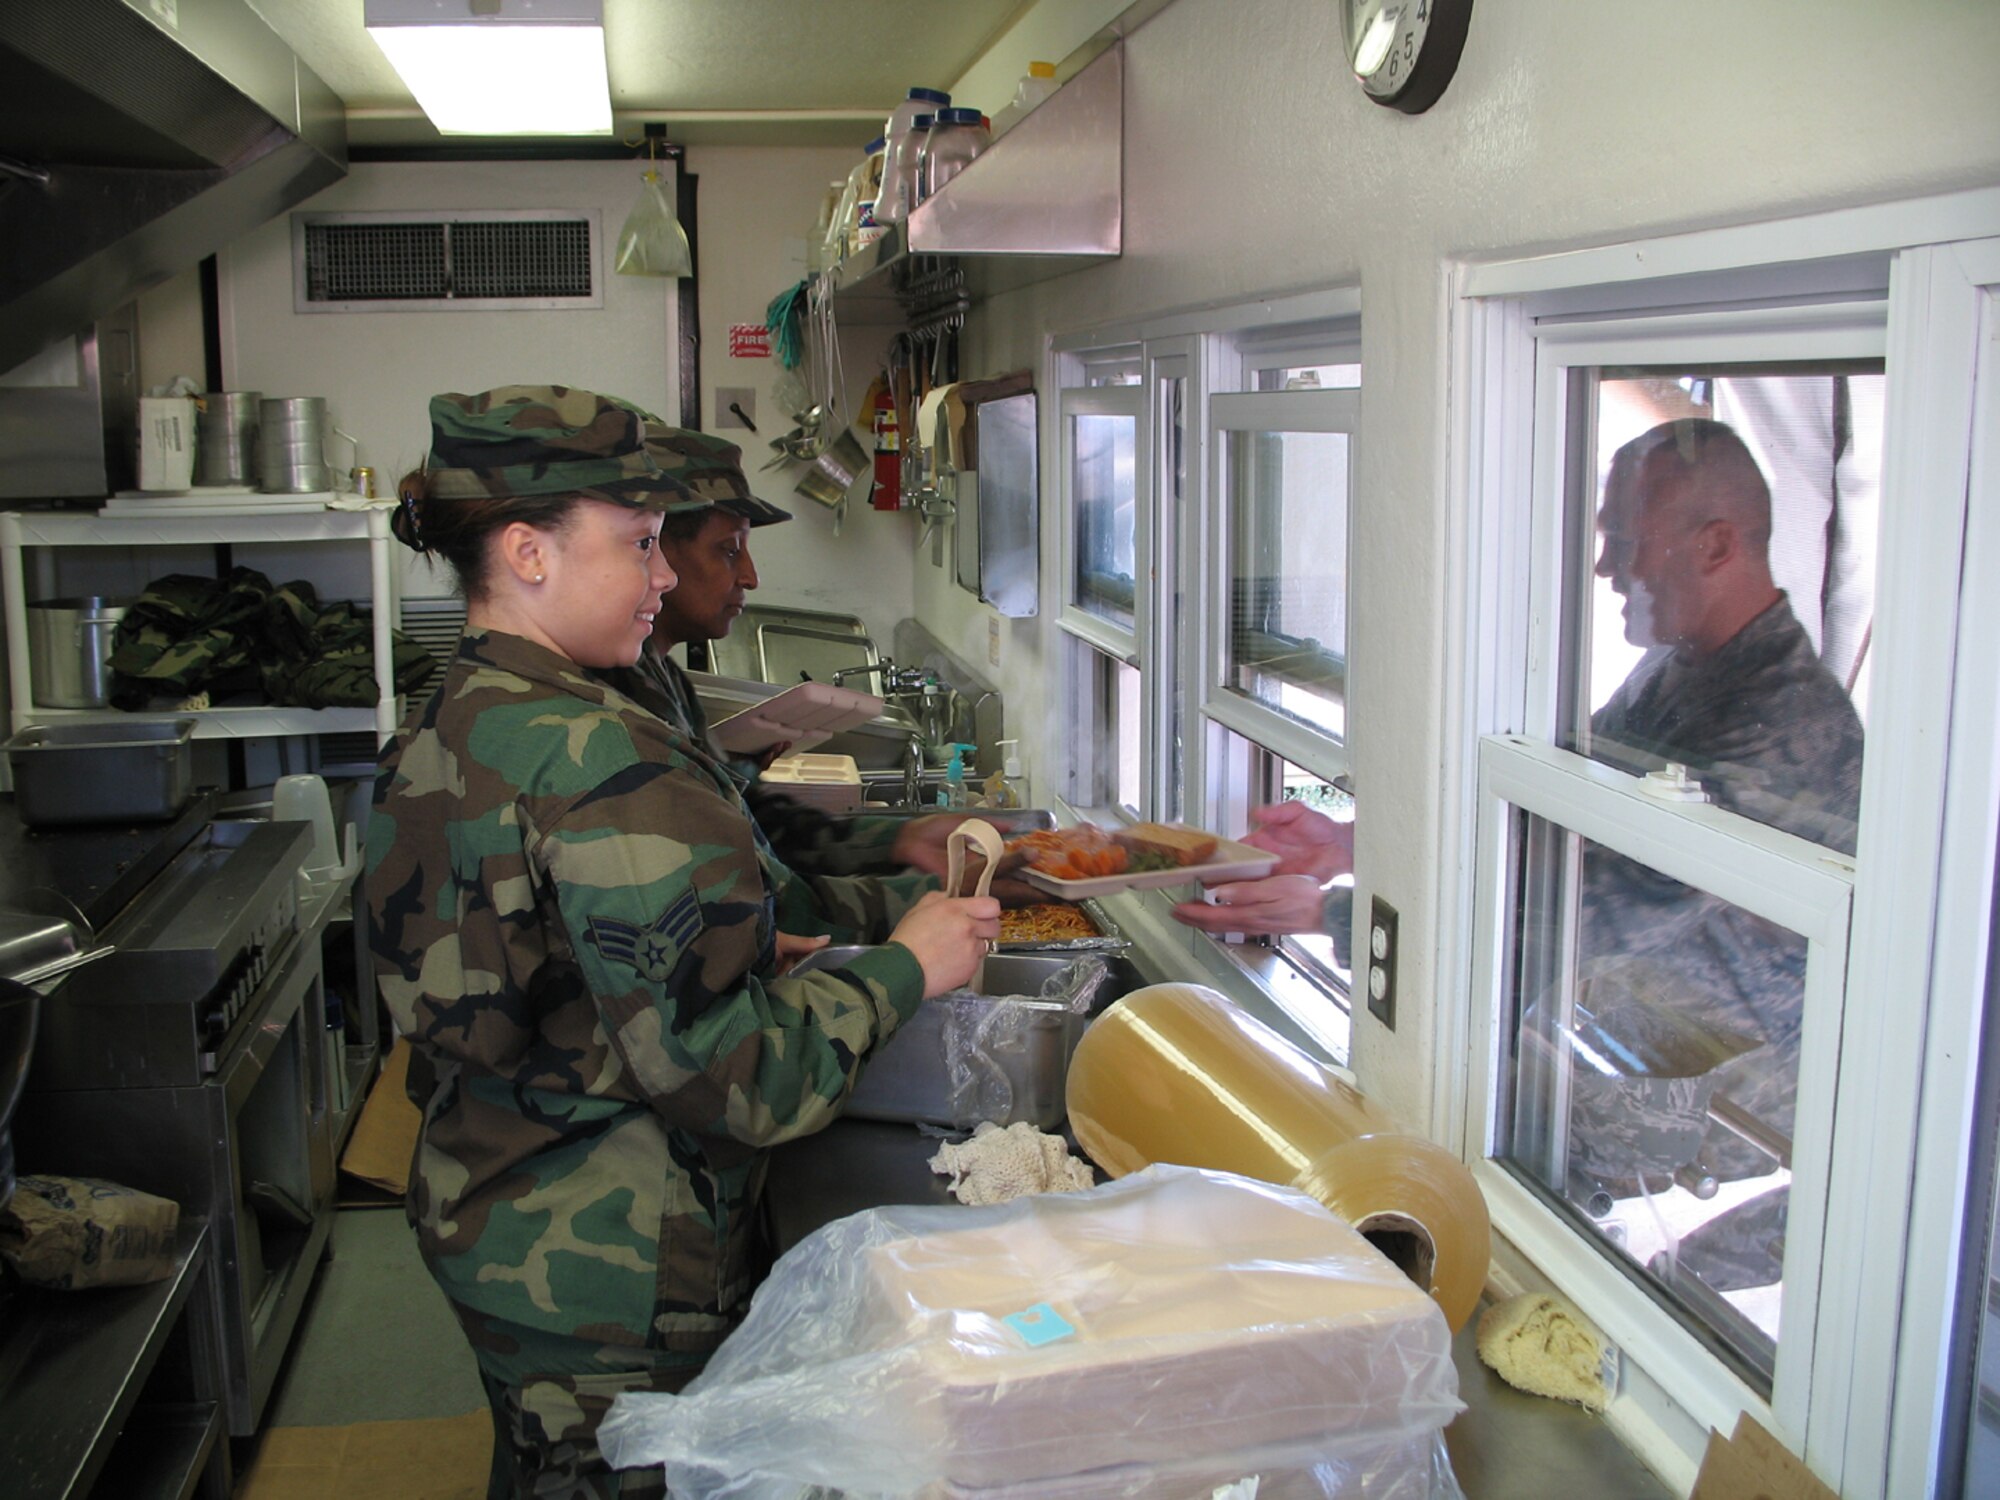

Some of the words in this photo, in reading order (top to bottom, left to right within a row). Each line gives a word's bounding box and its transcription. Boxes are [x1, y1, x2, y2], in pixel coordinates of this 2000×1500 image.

[1417, 0, 1427, 22] 4
[1403, 32, 1414, 60] 5
[1389, 50, 1399, 77] 6
[737, 335, 766, 345] FIRE
